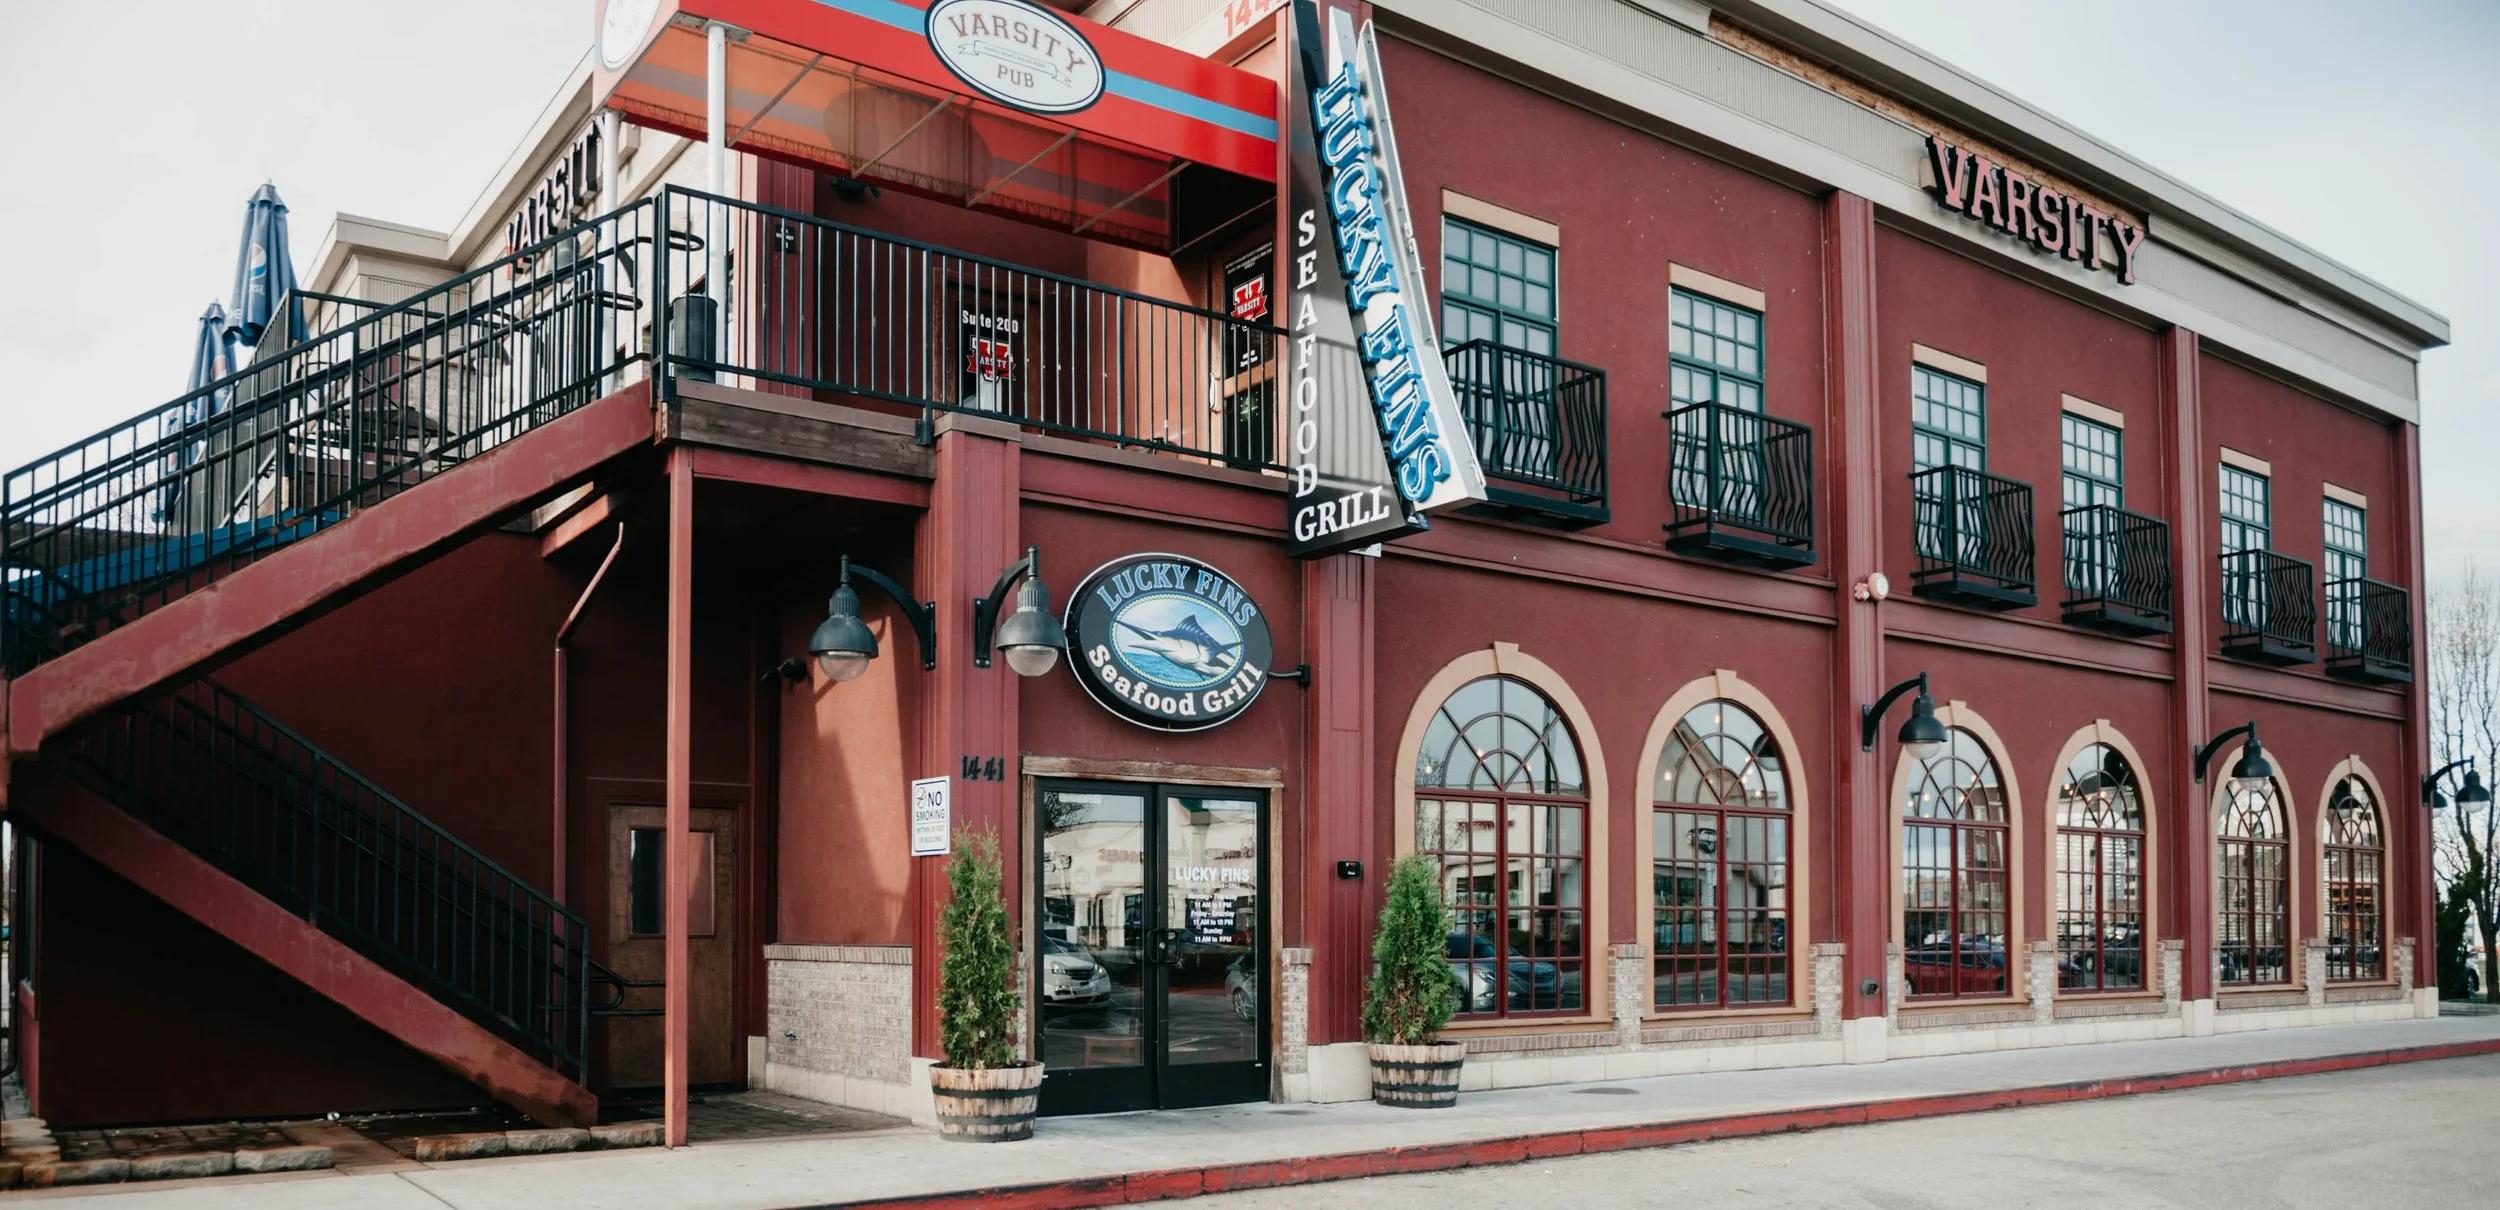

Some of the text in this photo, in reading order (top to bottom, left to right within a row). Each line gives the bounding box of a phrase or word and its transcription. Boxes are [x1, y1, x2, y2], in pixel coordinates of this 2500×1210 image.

[948, 13, 1085, 72] VARSITY
[997, 63, 1034, 88] PUB
[1926, 136, 2145, 285] VARSITY
[1313, 61, 1451, 502] LUCKY FINS
[1237, 297, 1260, 315] VARSITY
[962, 310, 1019, 333] Sute 200
[976, 355, 1007, 369] ARSTY
[1295, 209, 1317, 498] SEAFOOD
[1294, 485, 1390, 542] GRILL
[1097, 563, 1256, 626] LUCKY FINS
[1088, 644, 1263, 716] Seafood Grill
[962, 755, 1004, 781] 1441
[928, 791, 942, 807] NO
[916, 809, 945, 821] SMOKING
[1175, 866, 1250, 882] LUCKY FINS
